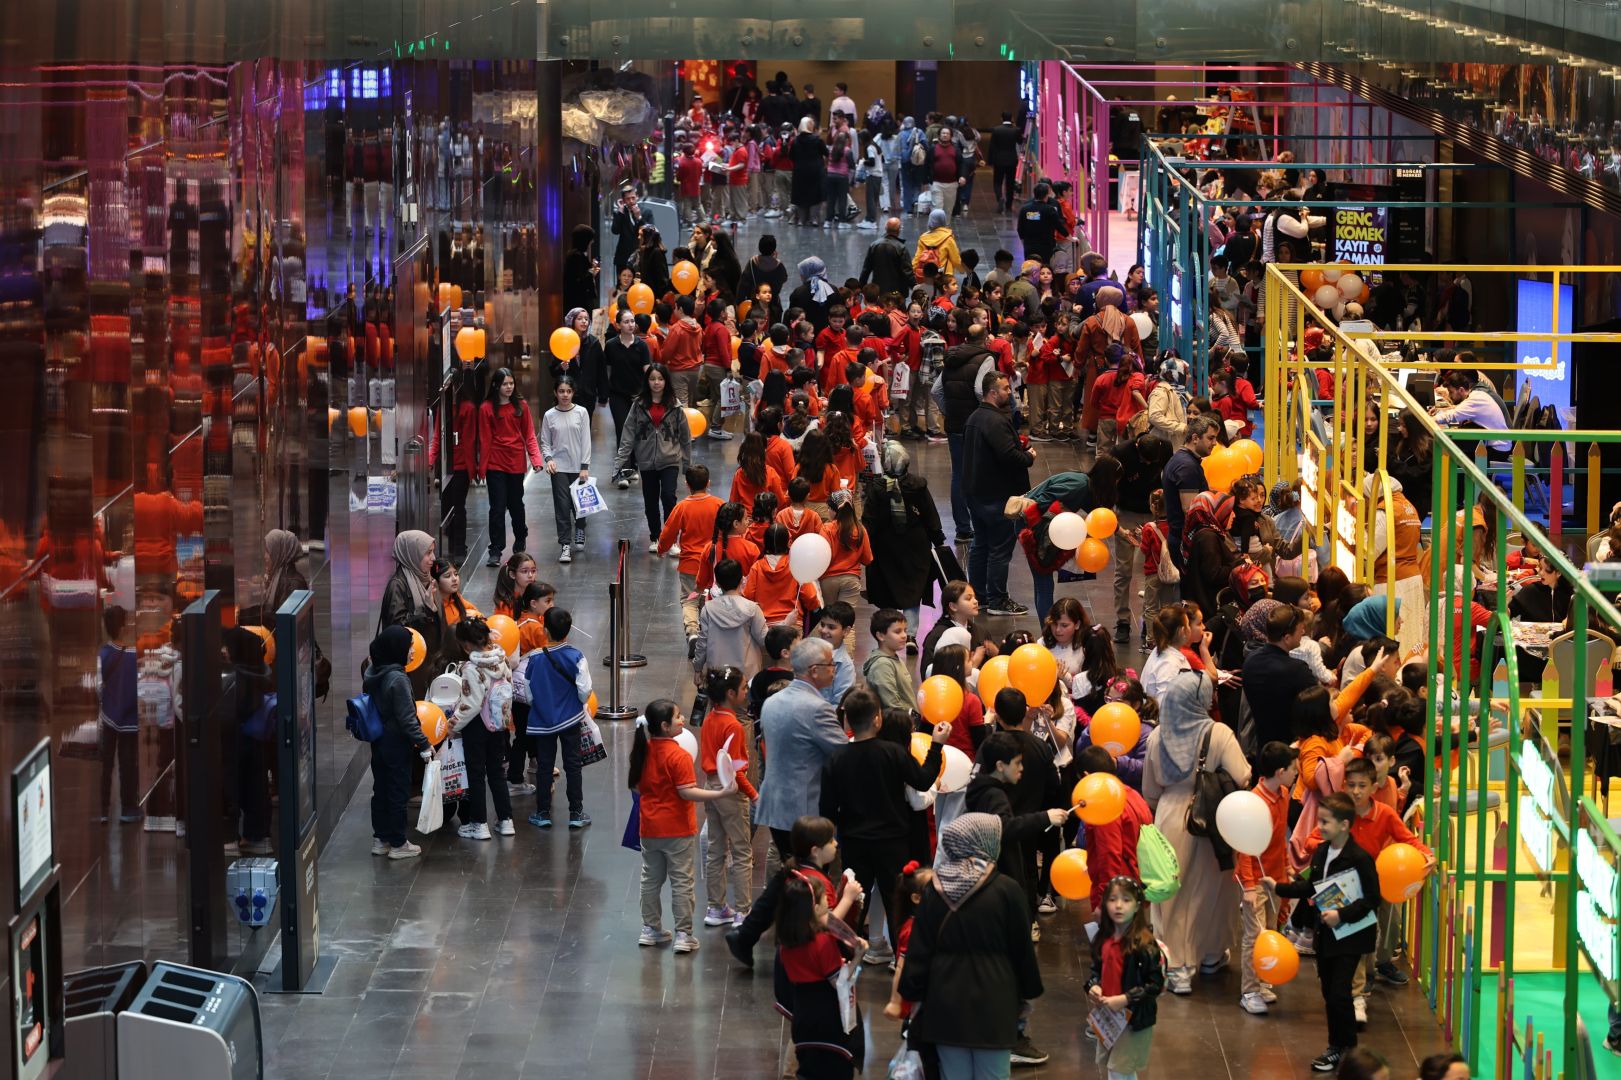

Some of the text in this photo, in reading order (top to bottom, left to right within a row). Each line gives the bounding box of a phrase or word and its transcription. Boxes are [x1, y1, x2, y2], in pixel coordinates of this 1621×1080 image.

[1335, 225, 1384, 241] KOMEK
[1335, 239, 1369, 253] KAYIT
[1335, 252, 1384, 264] ZAMANI
